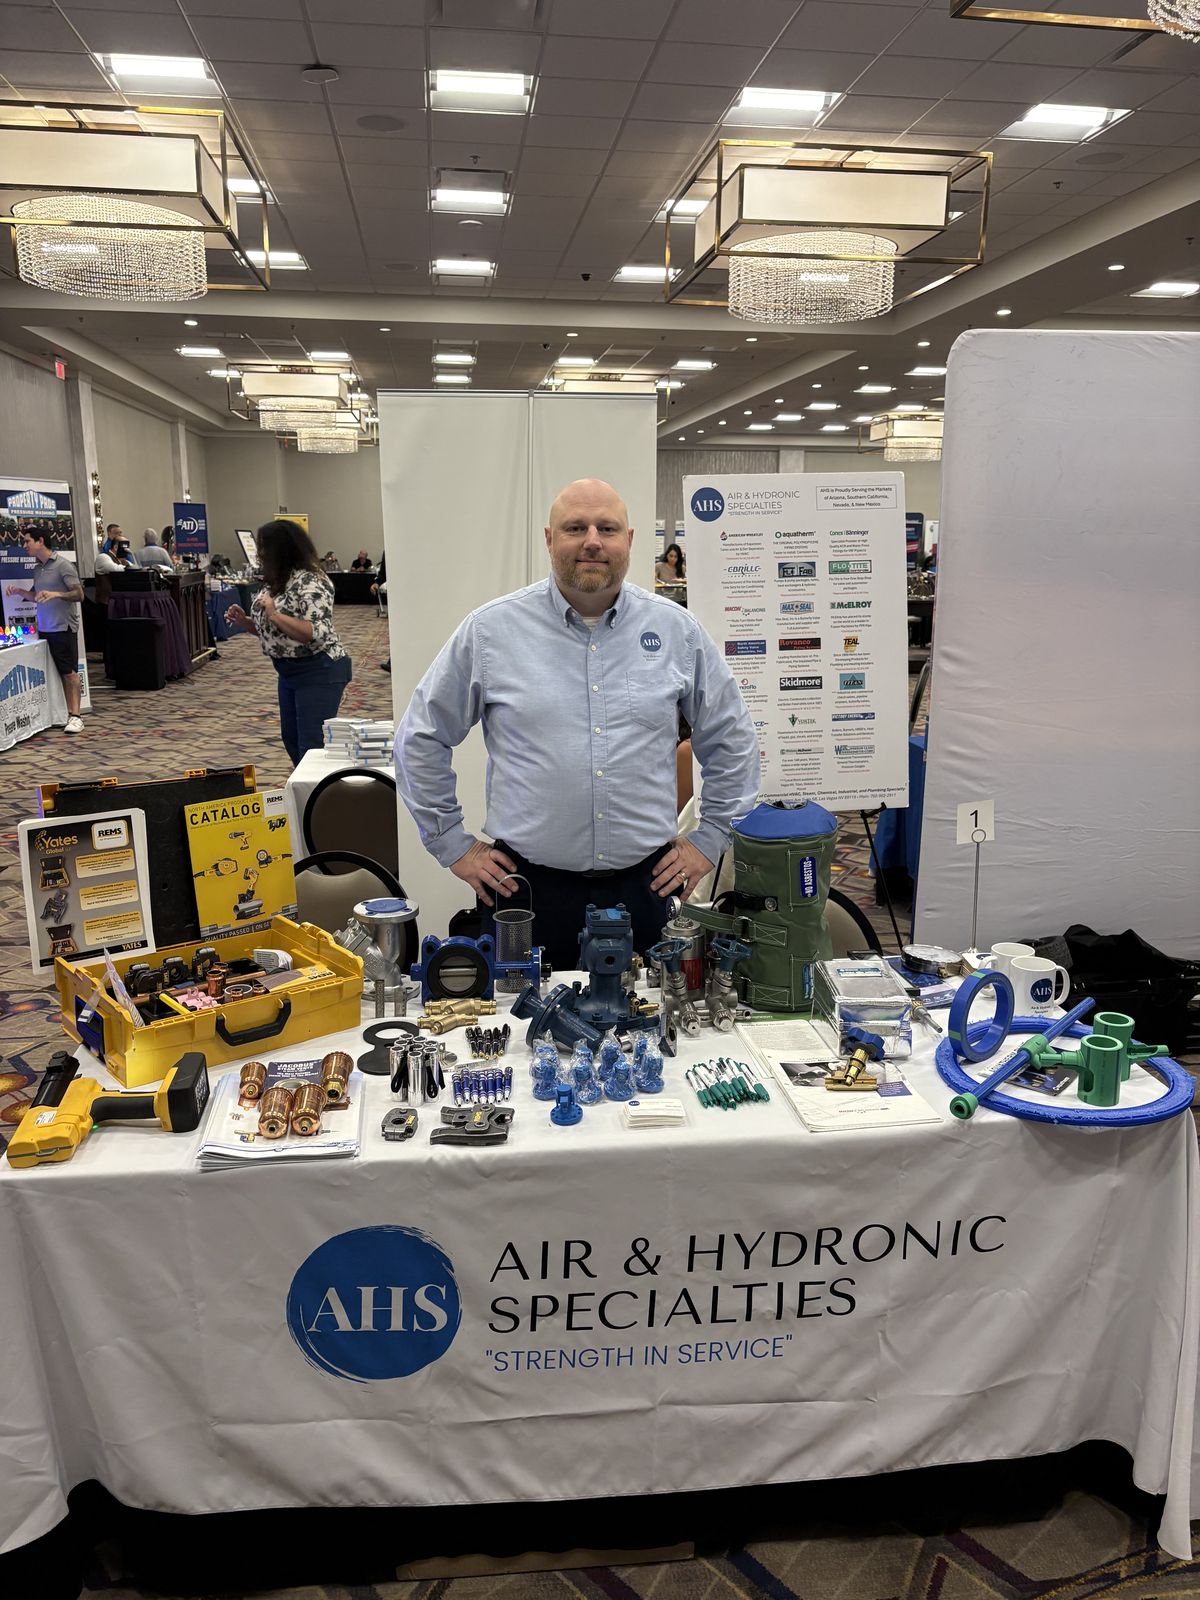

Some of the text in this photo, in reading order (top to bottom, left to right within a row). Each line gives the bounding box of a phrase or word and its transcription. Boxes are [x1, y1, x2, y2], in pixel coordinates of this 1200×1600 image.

[752, 491, 800, 499] HYDRONIC
[694, 500, 722, 512] AHS
[728, 502, 782, 510] SPECIALTIES
[181, 521, 193, 530] ATI
[837, 601, 872, 609] McELROY
[780, 678, 820, 687] Skidmore
[190, 802, 260, 825] CATALOG
[970, 810, 978, 828] 1
[98, 828, 122, 837] REMS
[42, 835, 79, 849] Yates
[229, 927, 250, 937] PASSED
[122, 941, 142, 950] YATES
[1033, 986, 1052, 996] AHS
[490, 1216, 1006, 1282] AIR & HYDRONIC
[307, 1284, 448, 1332] AHS
[489, 1278, 855, 1333] SPECIALTIES
[486, 1334, 793, 1372] "STRENGTH IN SERVICE"
